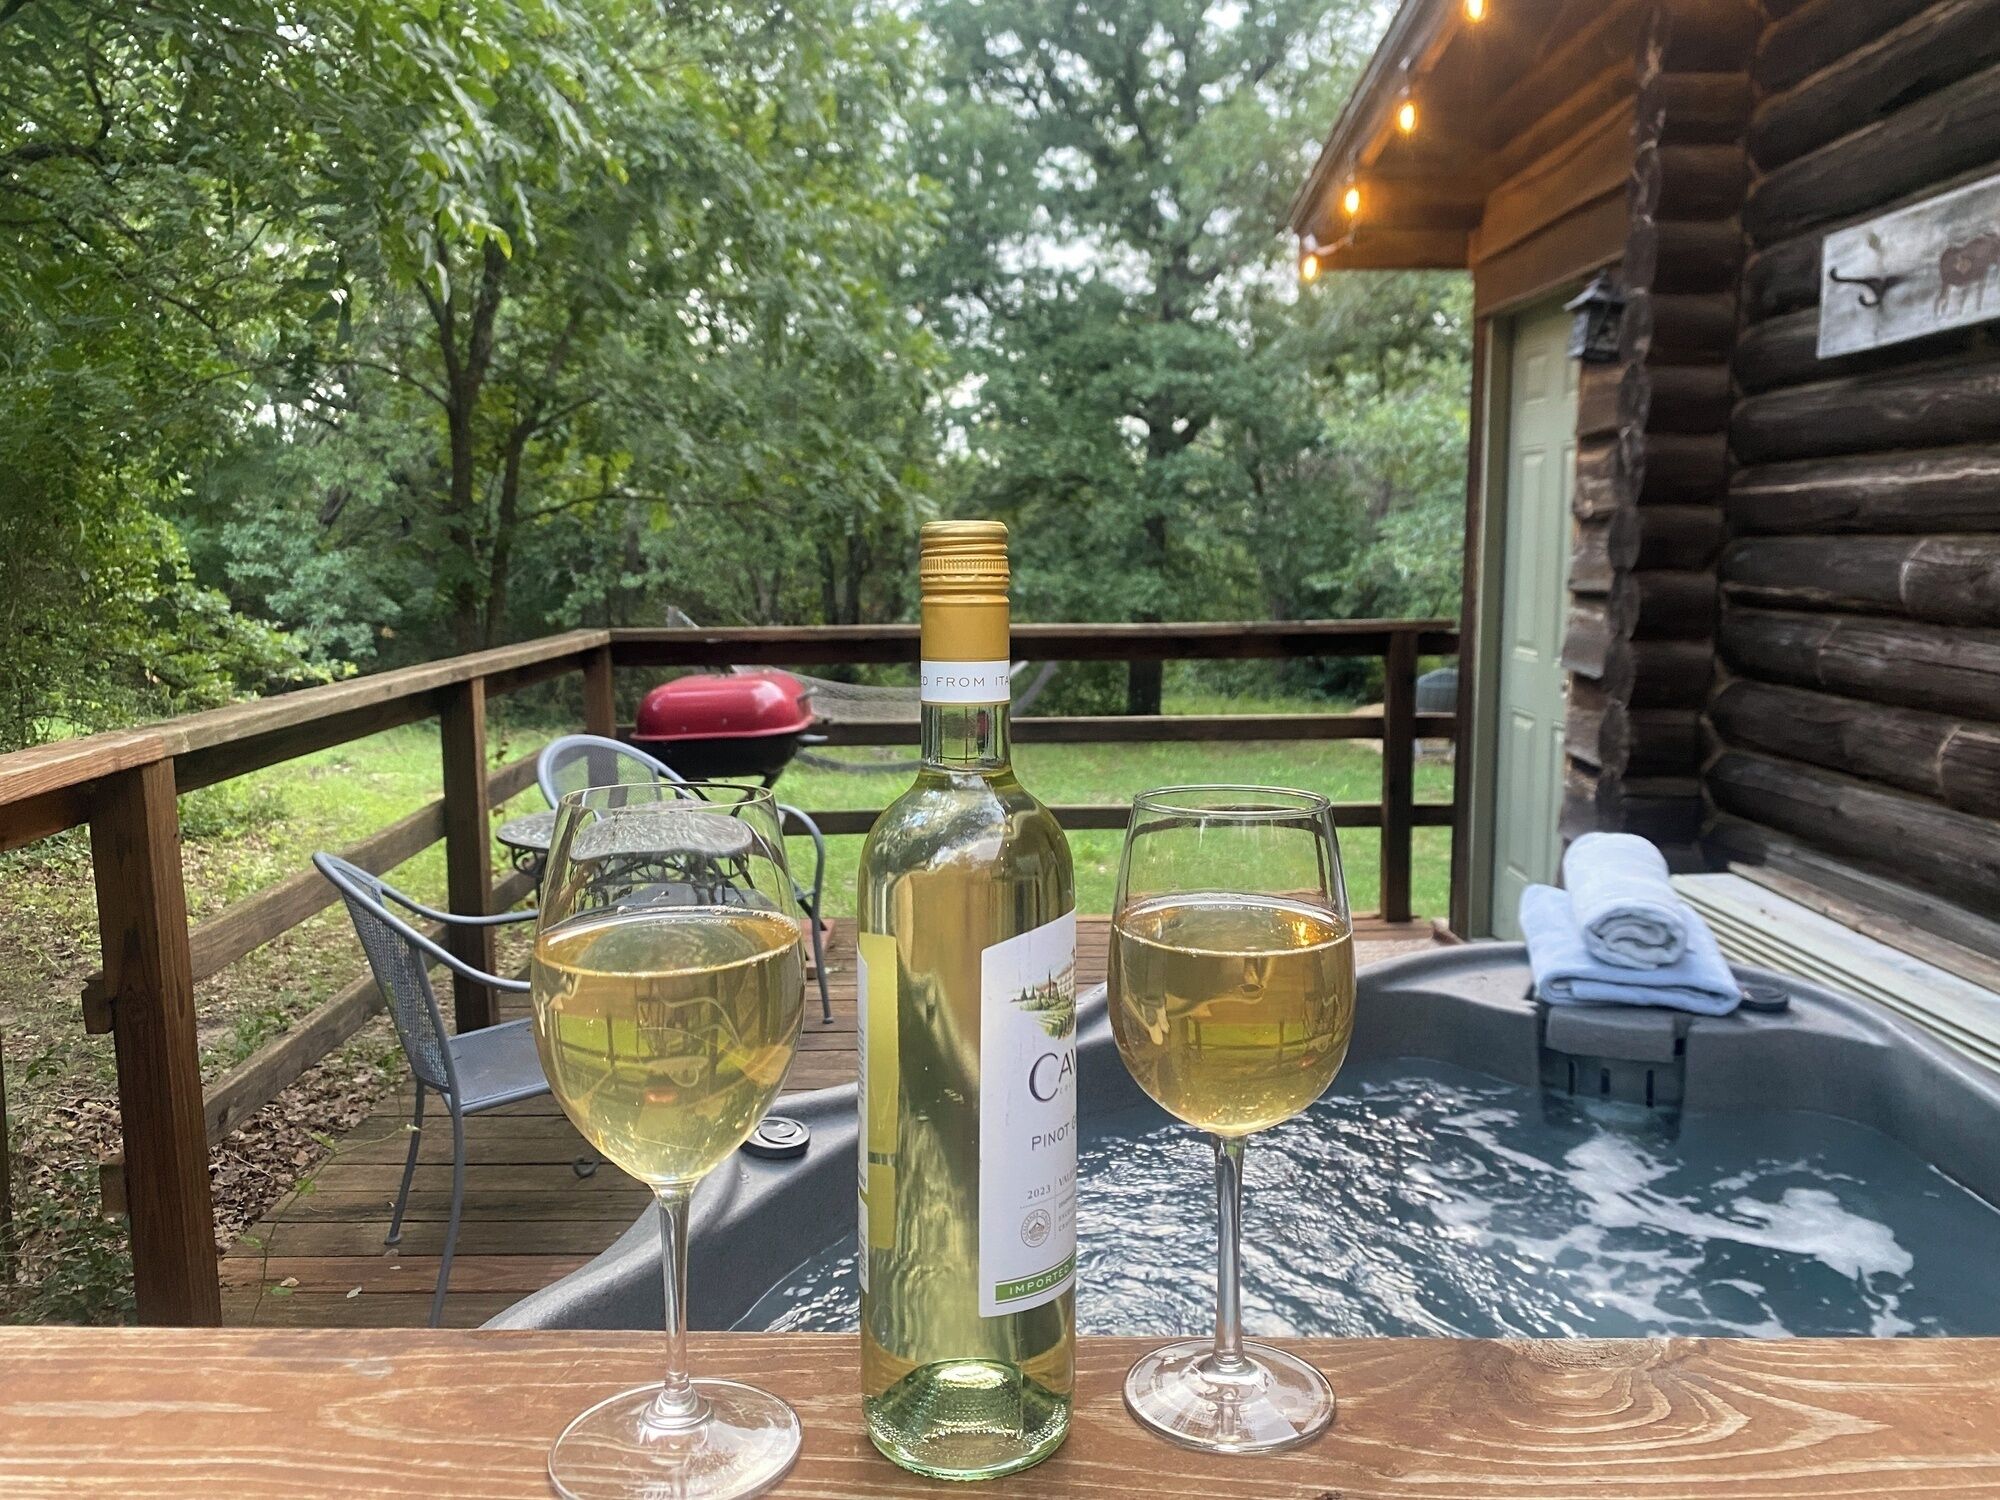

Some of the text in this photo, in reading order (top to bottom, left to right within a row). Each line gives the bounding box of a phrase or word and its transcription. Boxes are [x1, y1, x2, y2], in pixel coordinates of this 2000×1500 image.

[936, 677, 985, 687] FROM
[1032, 1122, 1070, 1151] PINOT
[1027, 1185, 1051, 1199] 2023
[1009, 1264, 1069, 1295] IMPORTED
